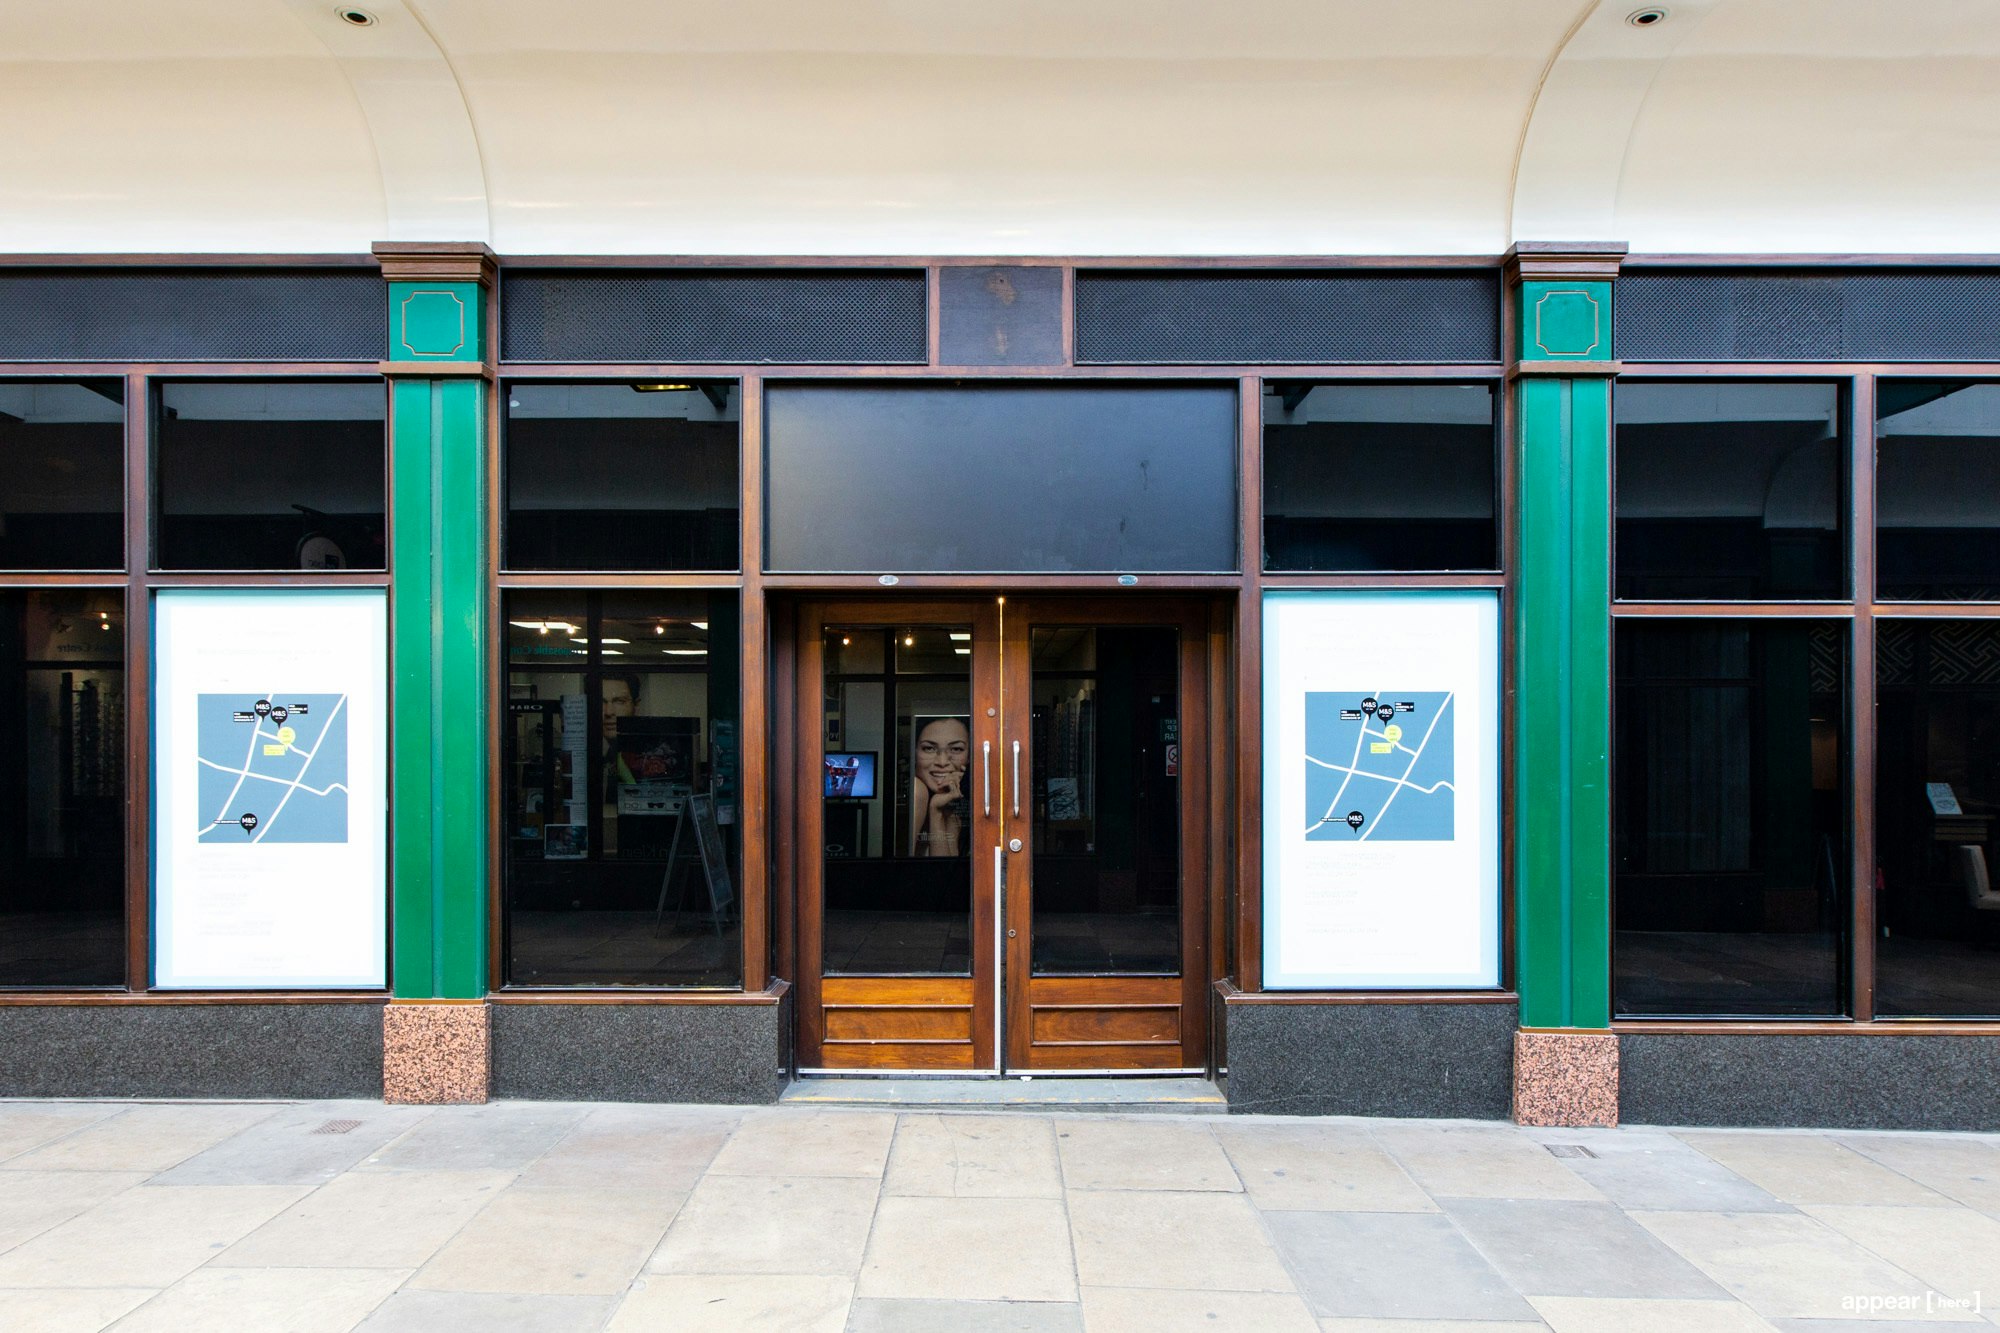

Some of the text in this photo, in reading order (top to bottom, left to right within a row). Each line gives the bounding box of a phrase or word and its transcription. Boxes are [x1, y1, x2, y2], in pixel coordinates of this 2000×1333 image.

[255, 703, 271, 711] M&S
[1362, 701, 1377, 709] M&S
[241, 816, 257, 824] M&S
